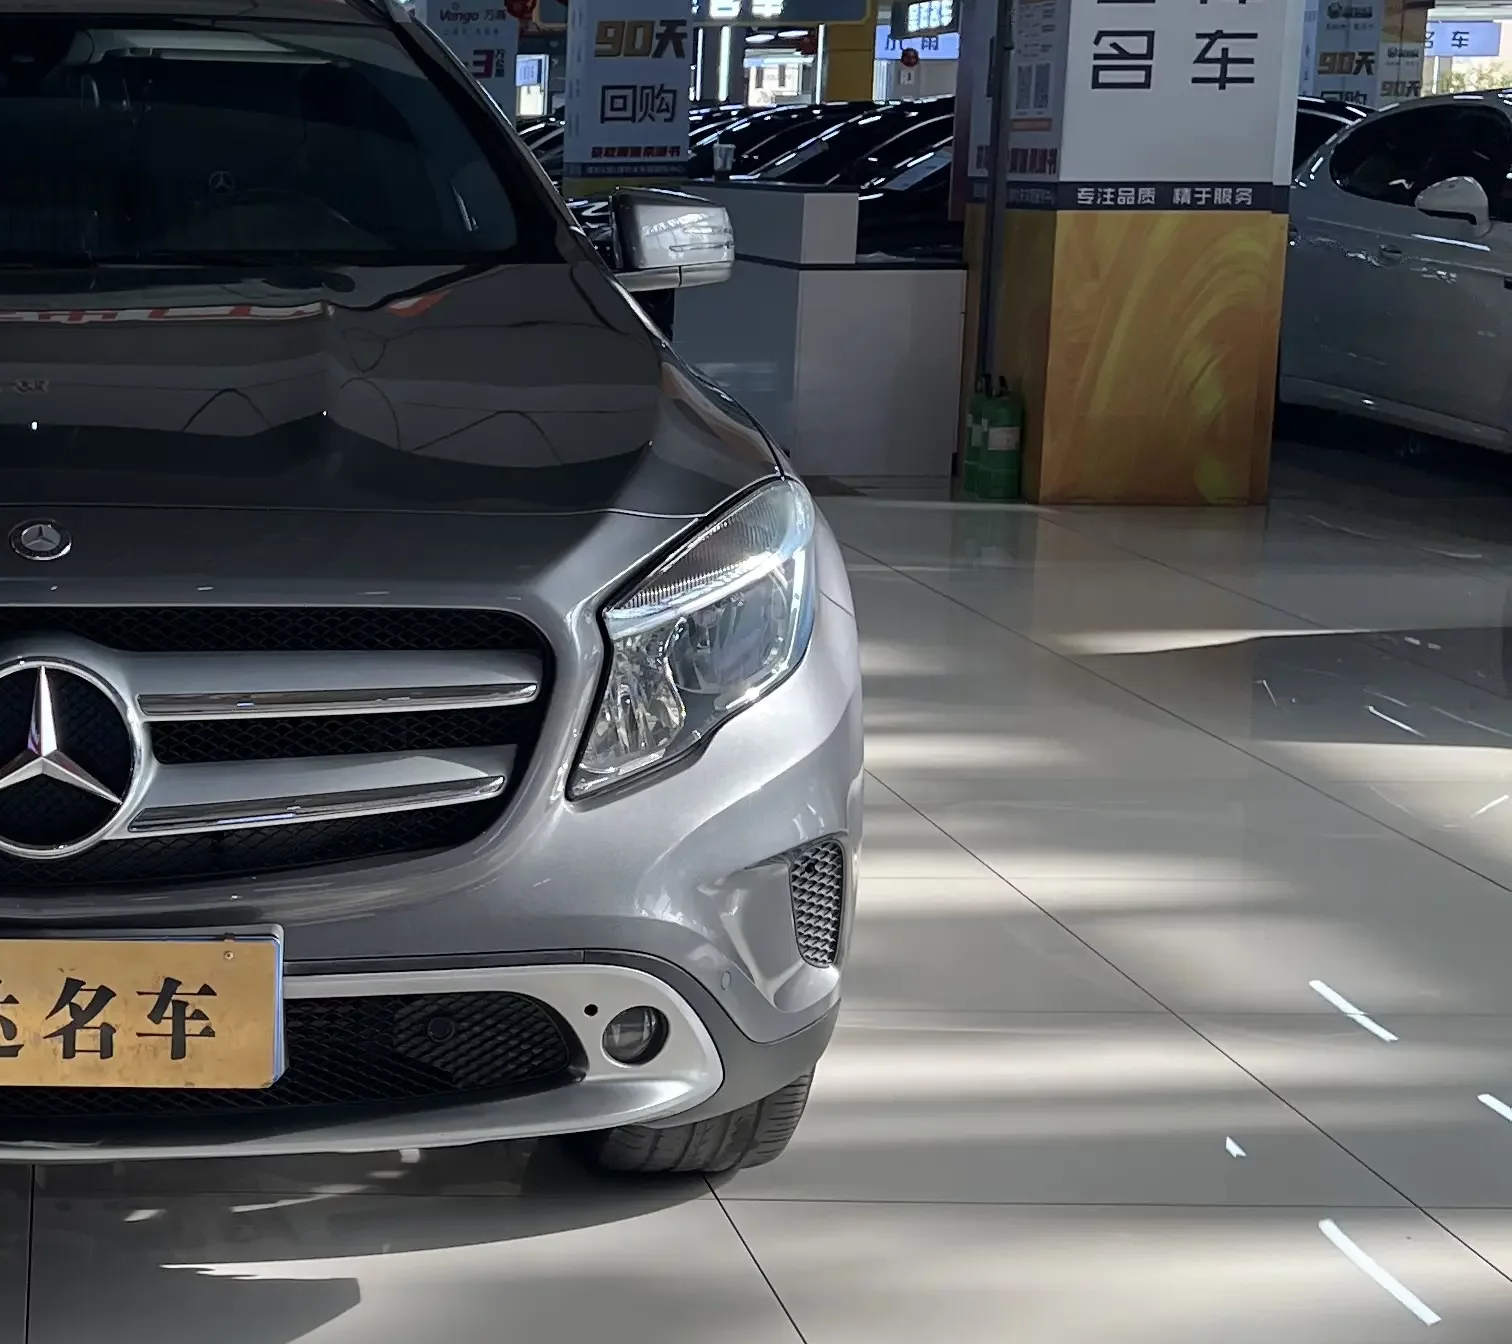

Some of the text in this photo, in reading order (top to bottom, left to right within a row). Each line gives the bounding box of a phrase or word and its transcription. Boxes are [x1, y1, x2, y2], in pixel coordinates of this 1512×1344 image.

[593, 19, 689, 59] 90天
[1317, 51, 1376, 77] 90天
[599, 83, 678, 124] 回购
[1076, 186, 1254, 206] 专注品质 精于服务
